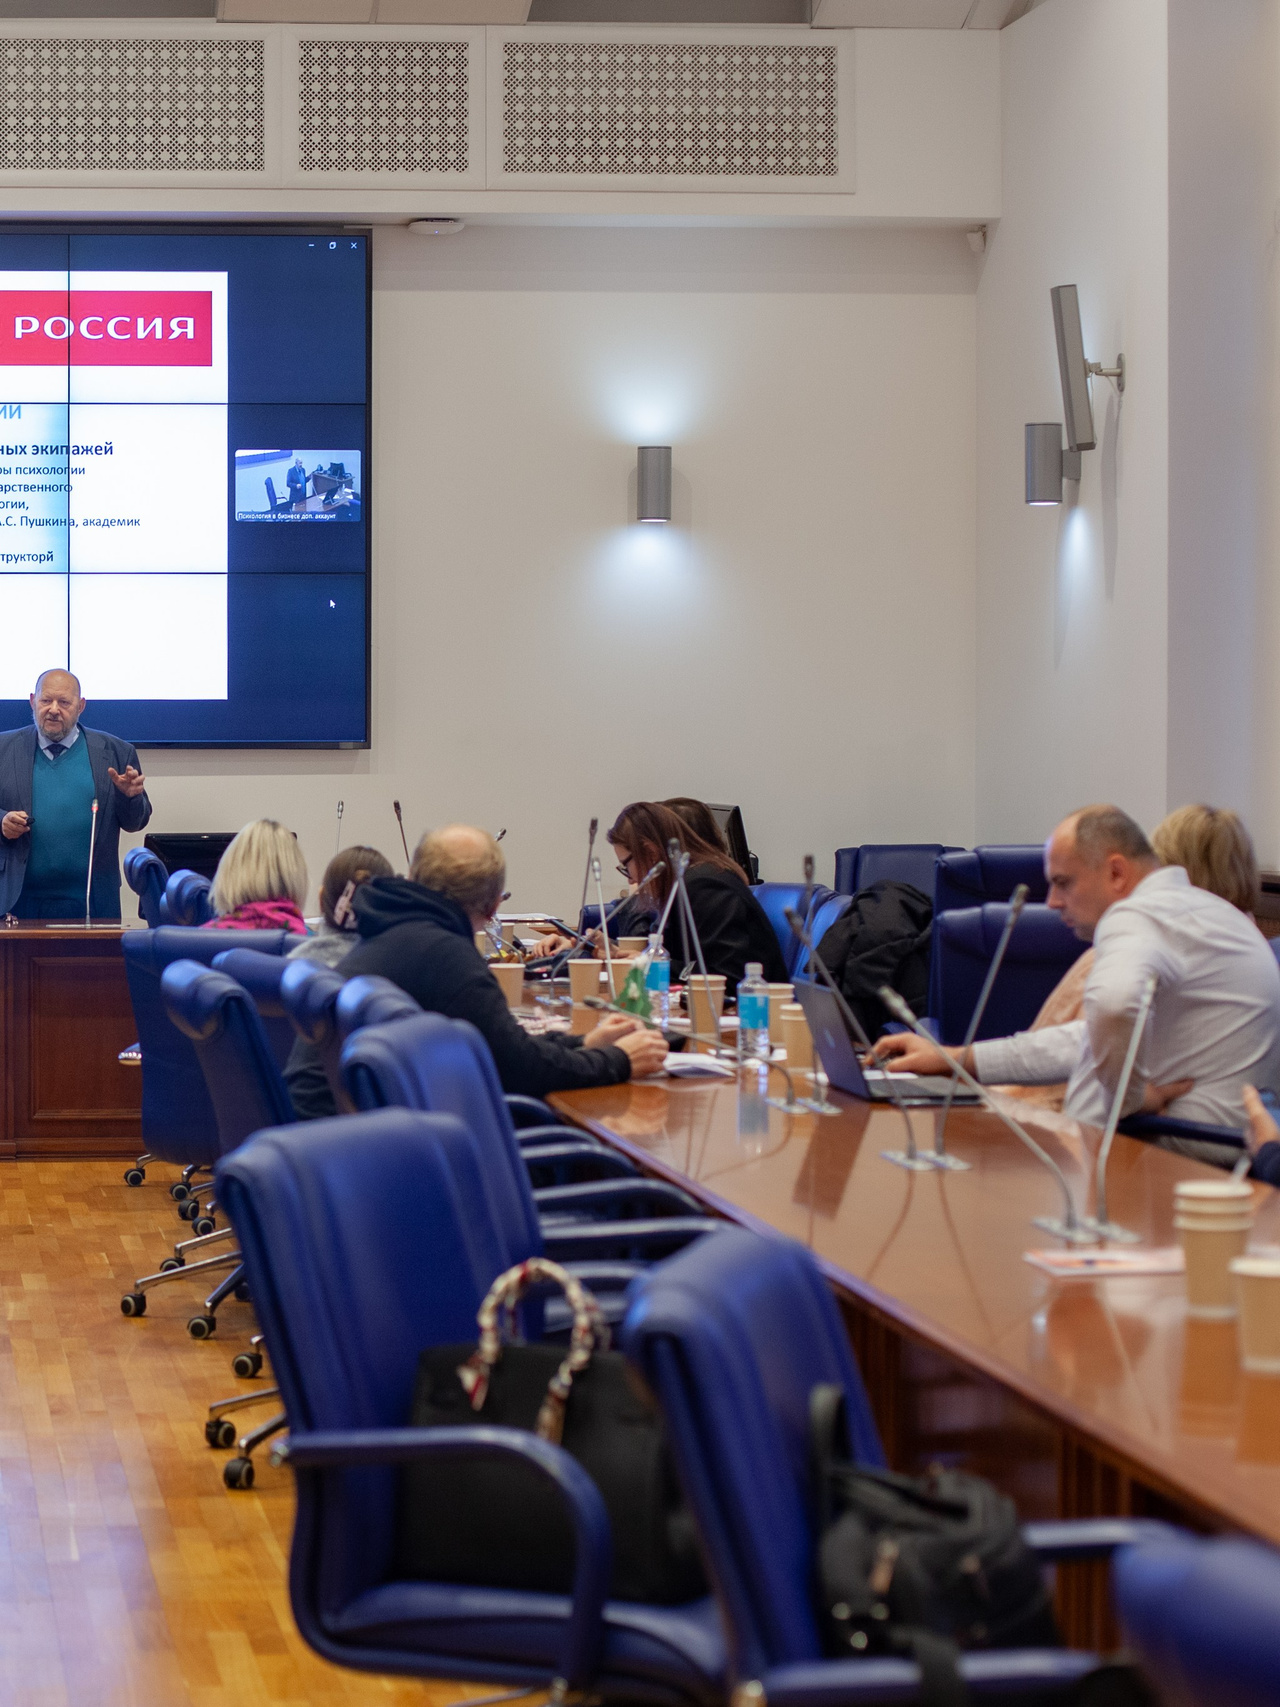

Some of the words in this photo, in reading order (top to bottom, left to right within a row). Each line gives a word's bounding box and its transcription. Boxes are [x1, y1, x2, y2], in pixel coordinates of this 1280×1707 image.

[14, 315, 195, 340] РОССИЯ
[32, 441, 114, 456] экипажей
[15, 466, 86, 478] психологии
[20, 516, 79, 529] Пушкина,
[82, 518, 141, 529] академик
